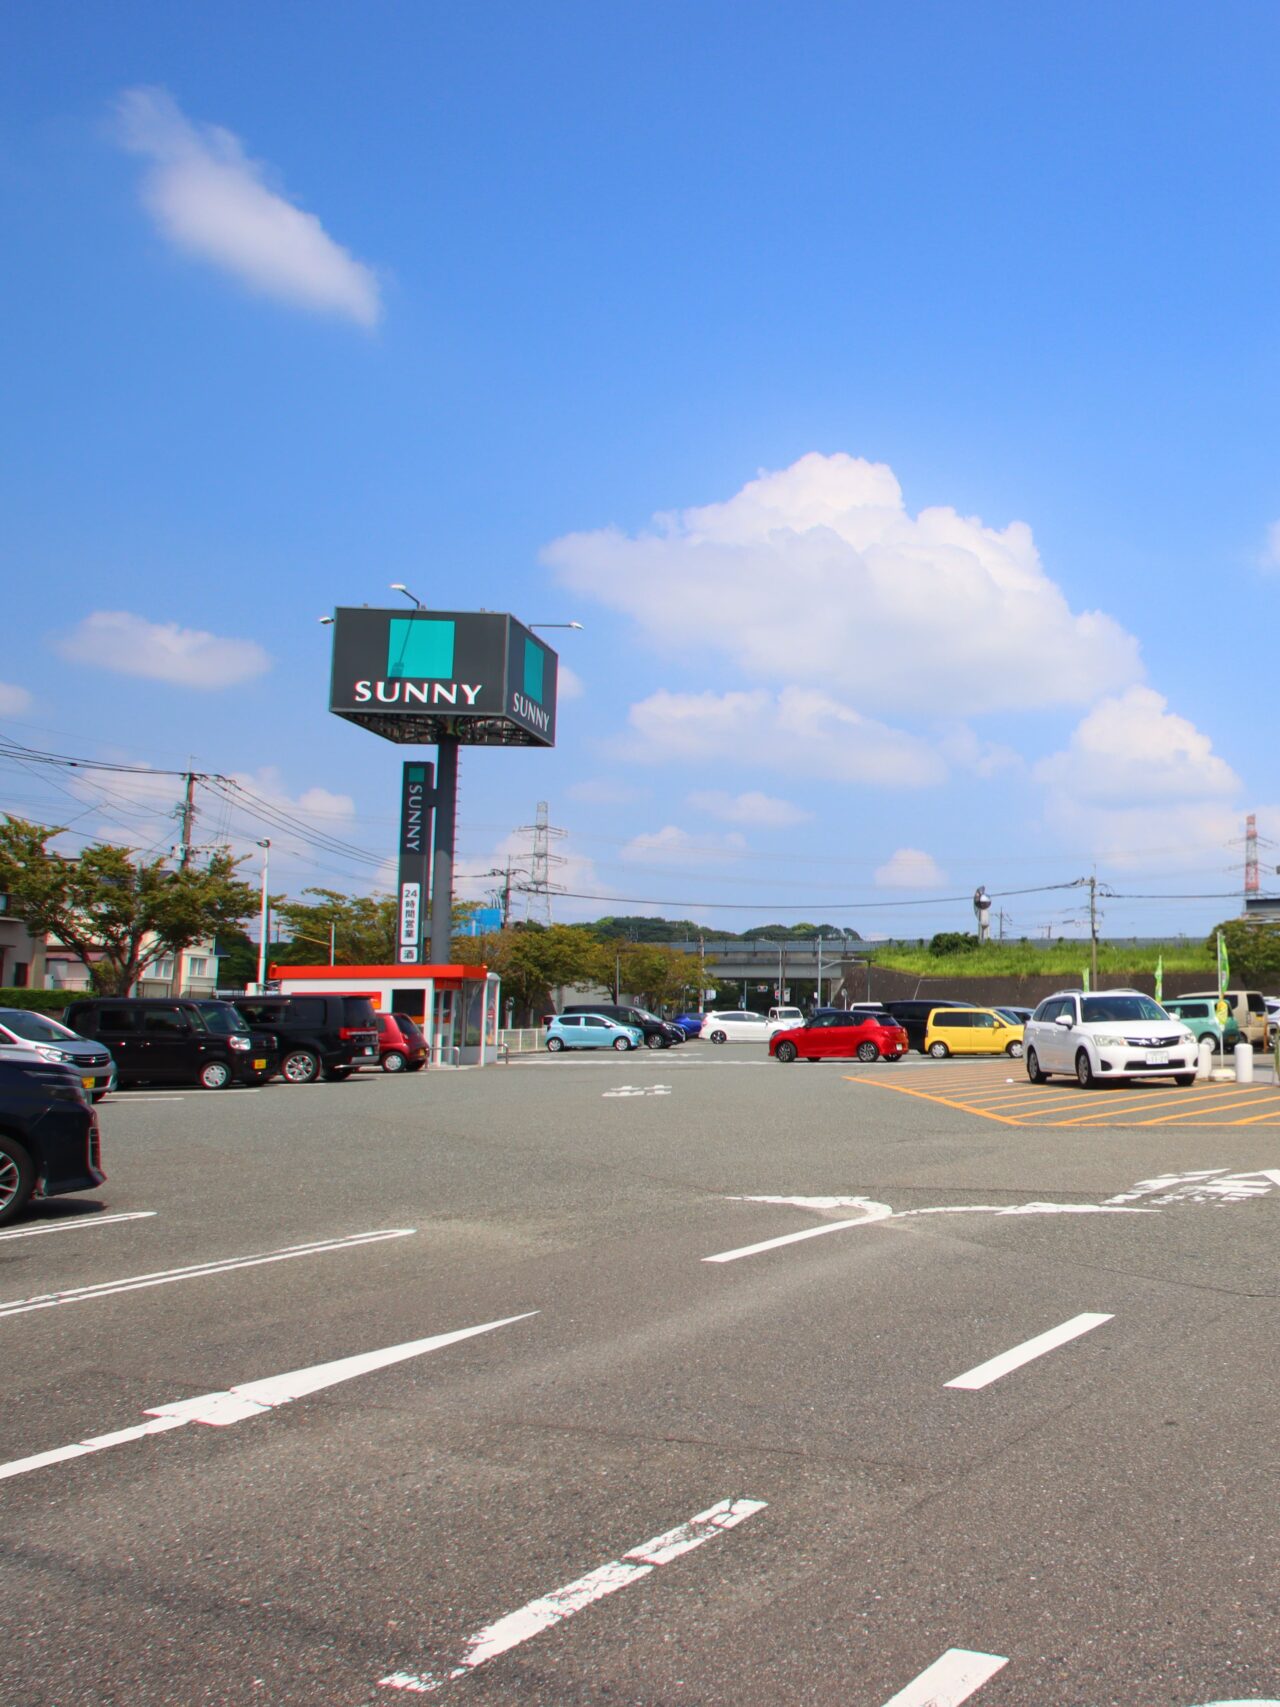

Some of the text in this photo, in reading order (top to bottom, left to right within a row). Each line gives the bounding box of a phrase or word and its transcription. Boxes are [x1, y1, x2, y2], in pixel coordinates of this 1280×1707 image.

[354, 680, 482, 705] SUNNY
[513, 692, 550, 732] SUNNY
[406, 784, 422, 851] SUNNY
[404, 889, 418, 938] 24時間営業
[403, 949, 415, 960] 酒
